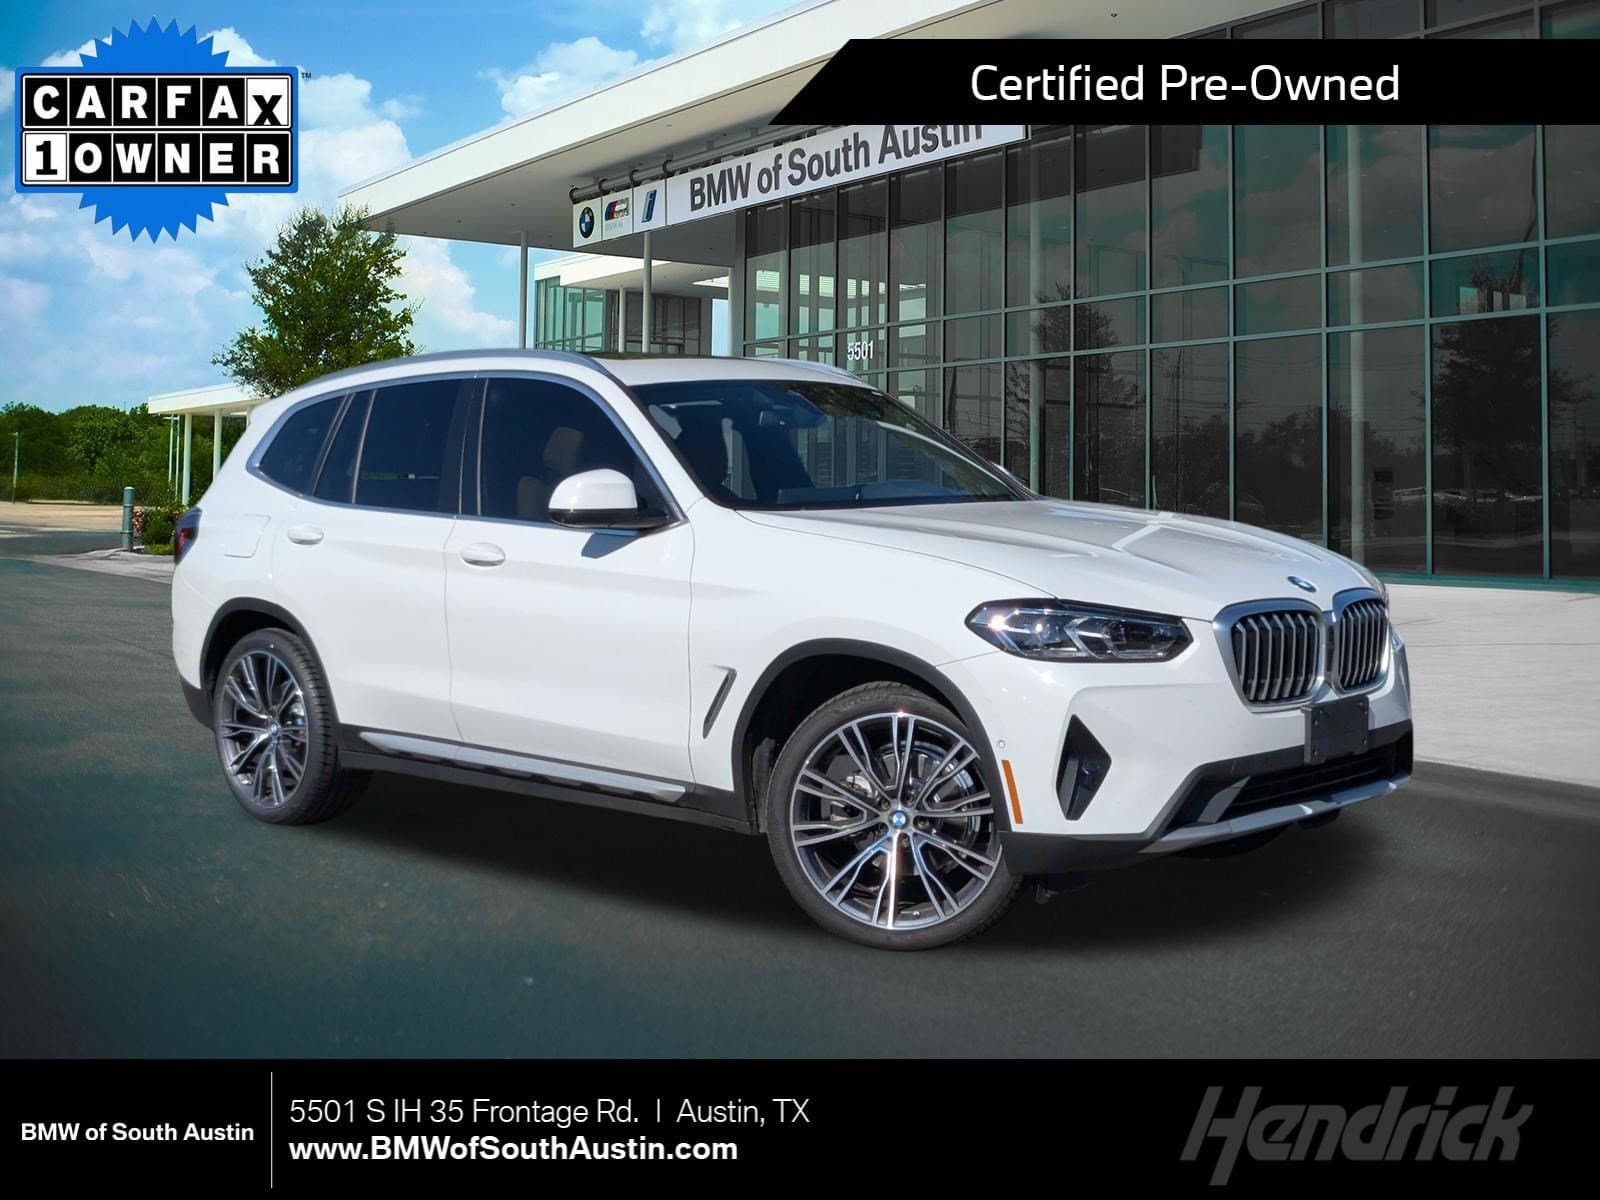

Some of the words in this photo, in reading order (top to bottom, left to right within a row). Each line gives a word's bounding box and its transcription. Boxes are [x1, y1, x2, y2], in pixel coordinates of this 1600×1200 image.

[690, 162, 751, 211] BMW
[757, 153, 783, 194] of
[788, 132, 870, 186] South
[847, 339, 874, 361] 5501
